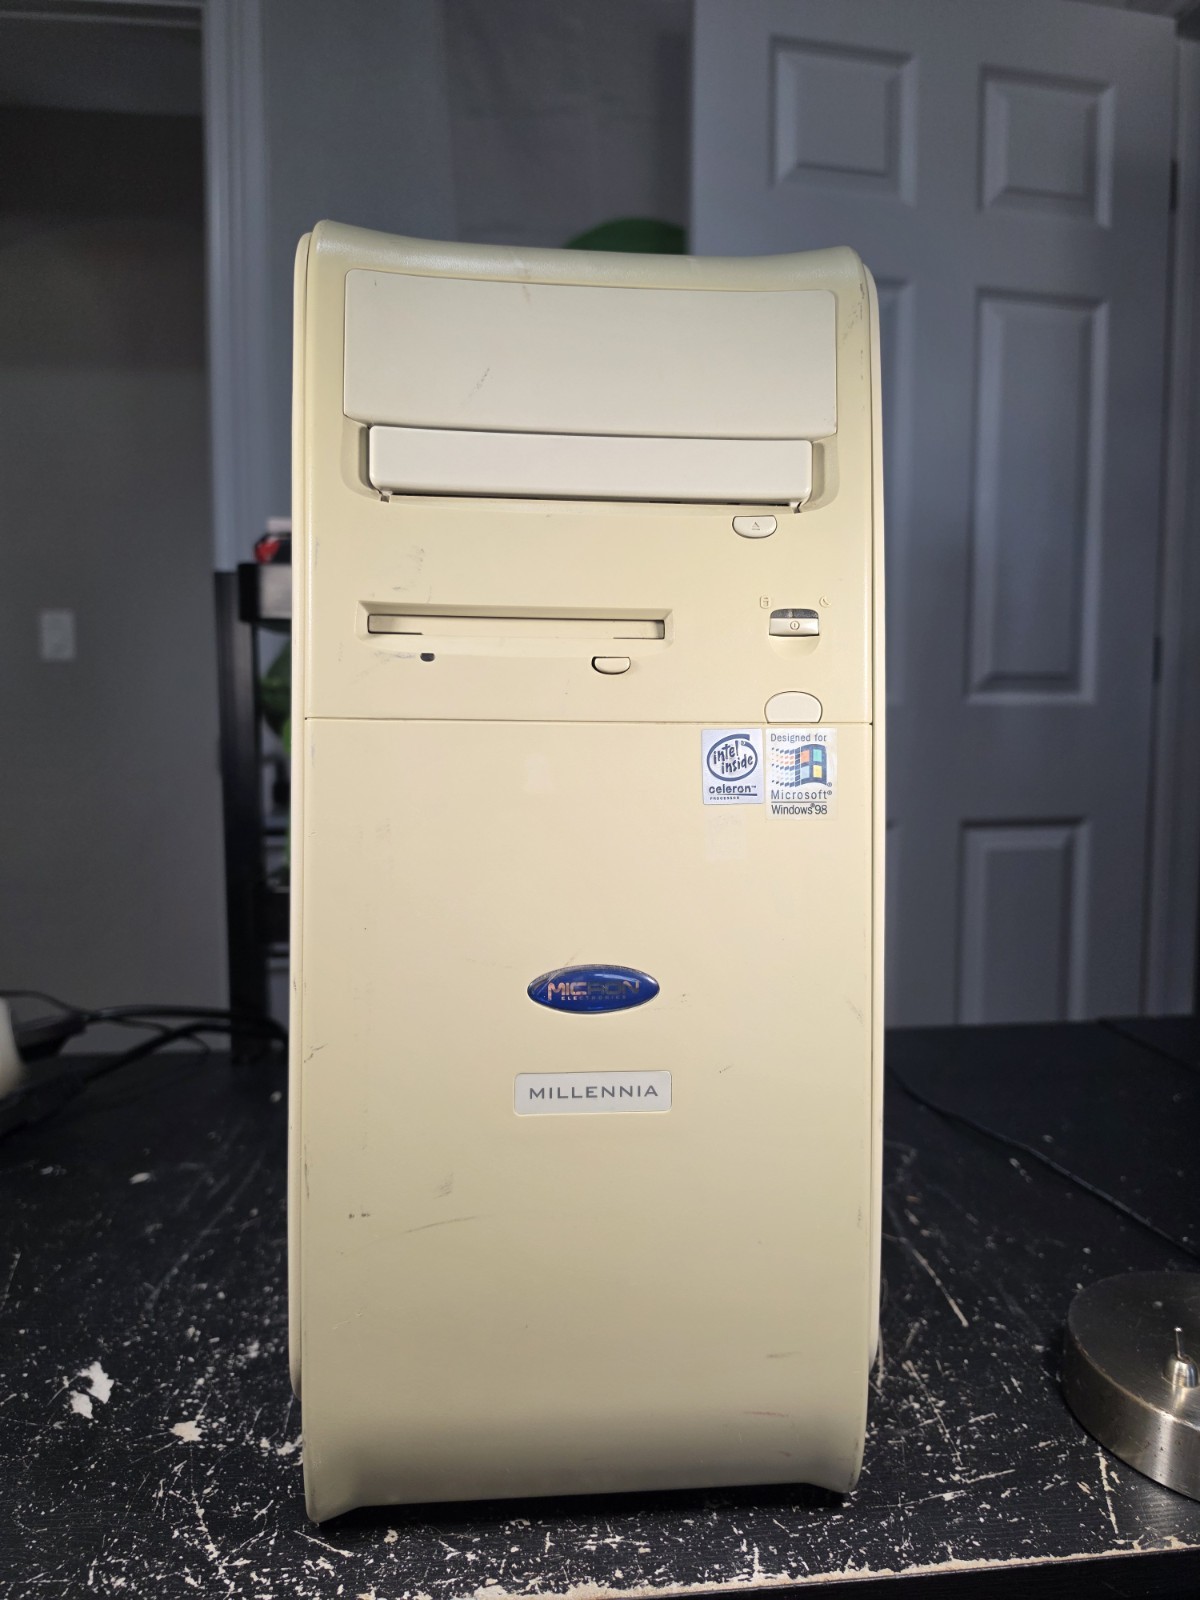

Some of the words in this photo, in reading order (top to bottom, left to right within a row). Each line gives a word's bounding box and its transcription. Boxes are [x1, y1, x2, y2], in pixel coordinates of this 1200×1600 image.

[770, 733, 811, 744] Designed
[814, 733, 827, 742] for
[713, 740, 739, 765] intel
[721, 753, 753, 775] inside
[547, 979, 640, 1001] MICRON
[529, 1085, 659, 1100] MILLENNIA
